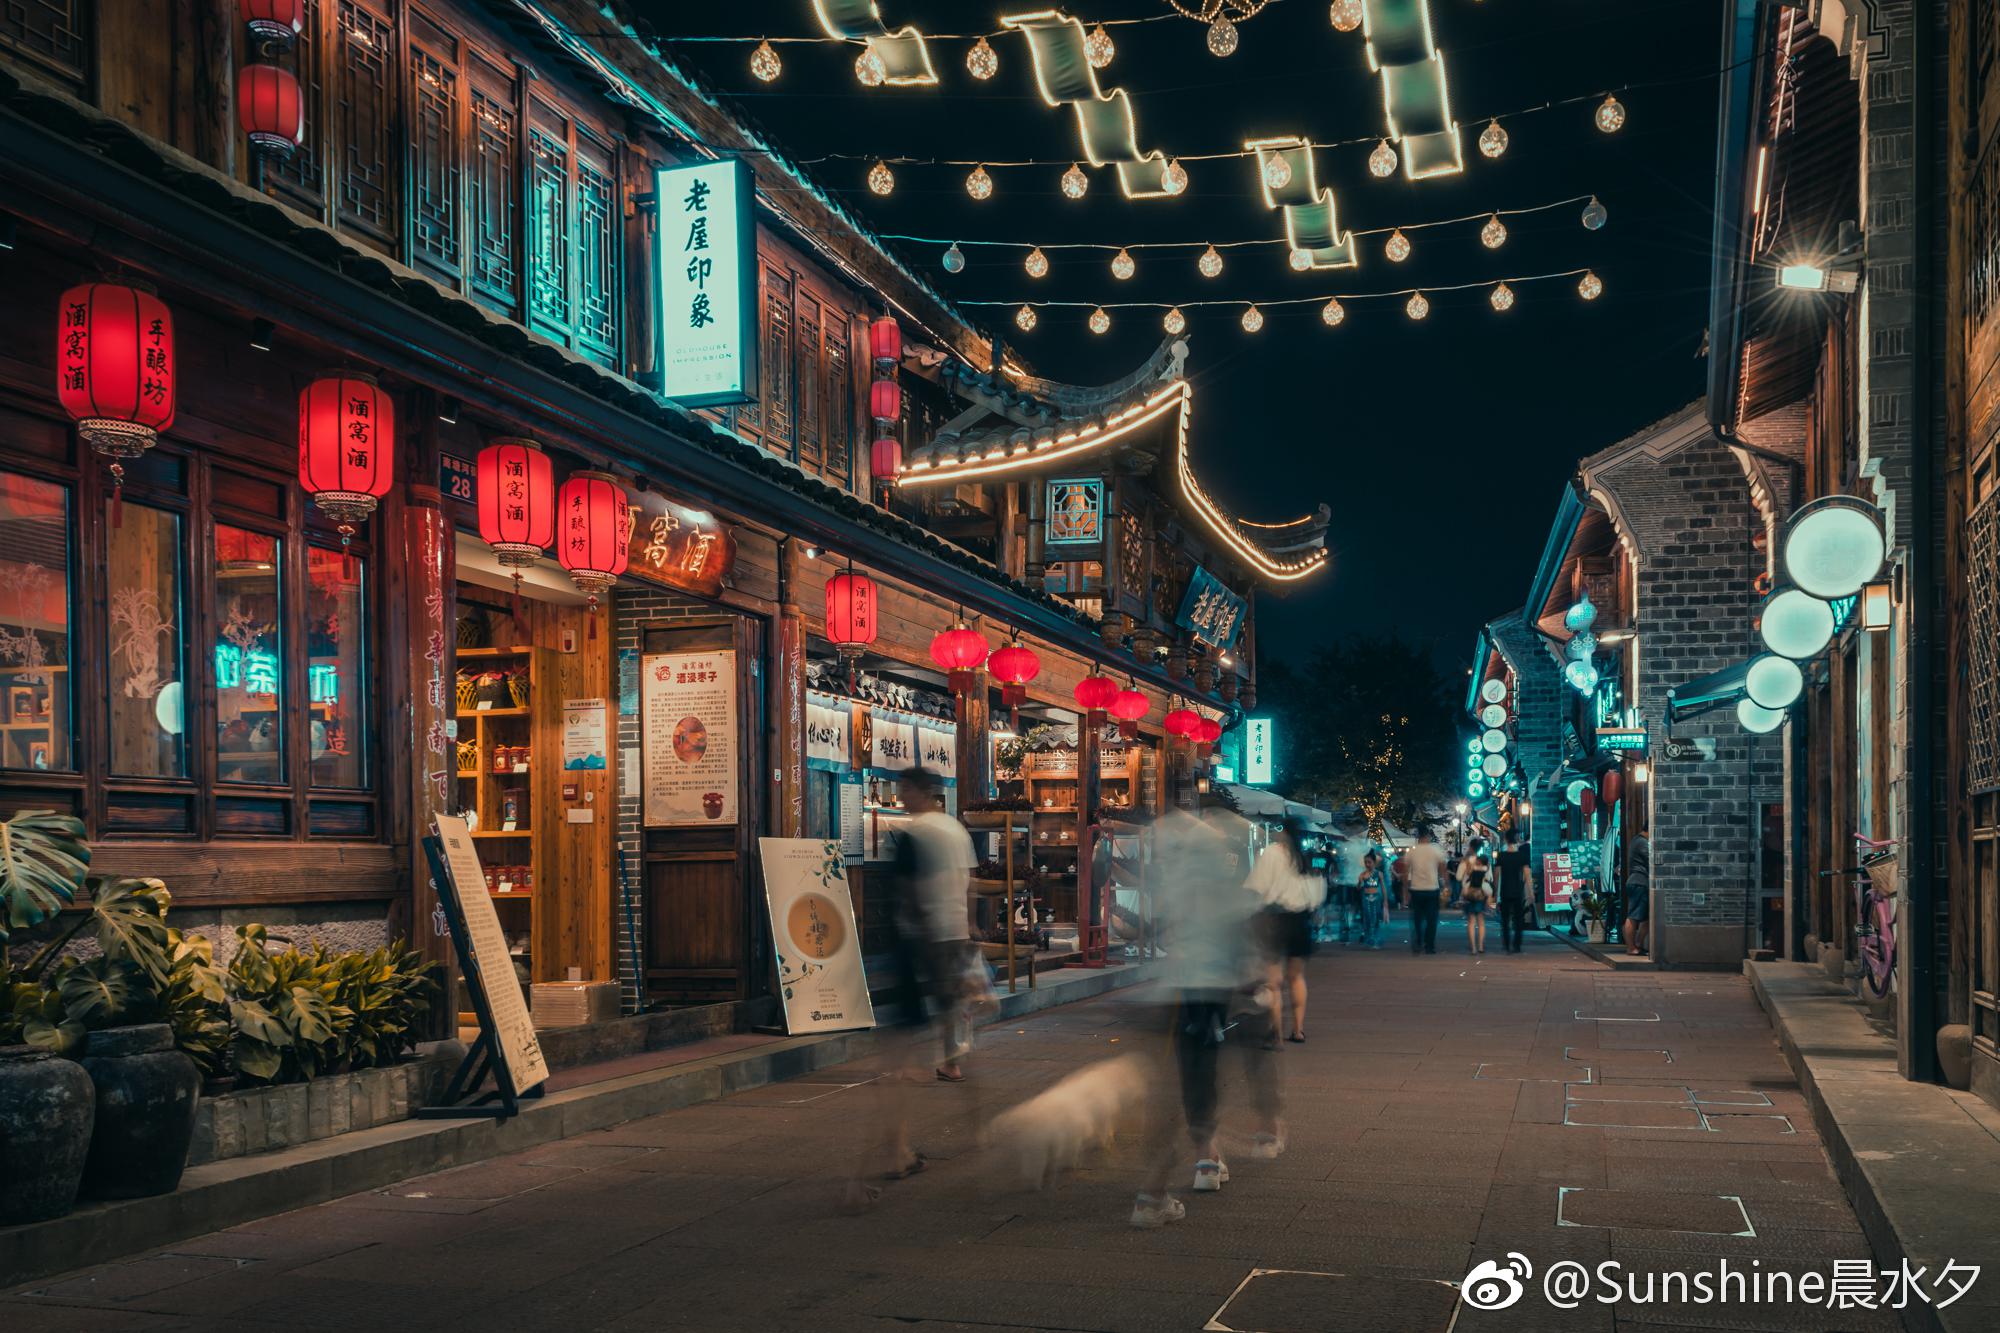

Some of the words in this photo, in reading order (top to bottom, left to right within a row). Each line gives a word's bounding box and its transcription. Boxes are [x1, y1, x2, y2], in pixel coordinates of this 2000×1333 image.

[684, 178, 714, 329] 老屋印象
[64, 303, 87, 392] 酒窝酒
[144, 319, 169, 406] 手酿坊
[347, 396, 370, 470] 酒窝酒
[451, 475, 471, 498] 28
[505, 459, 524, 522] 酒窝酒
[570, 496, 586, 553] 手酿坊
